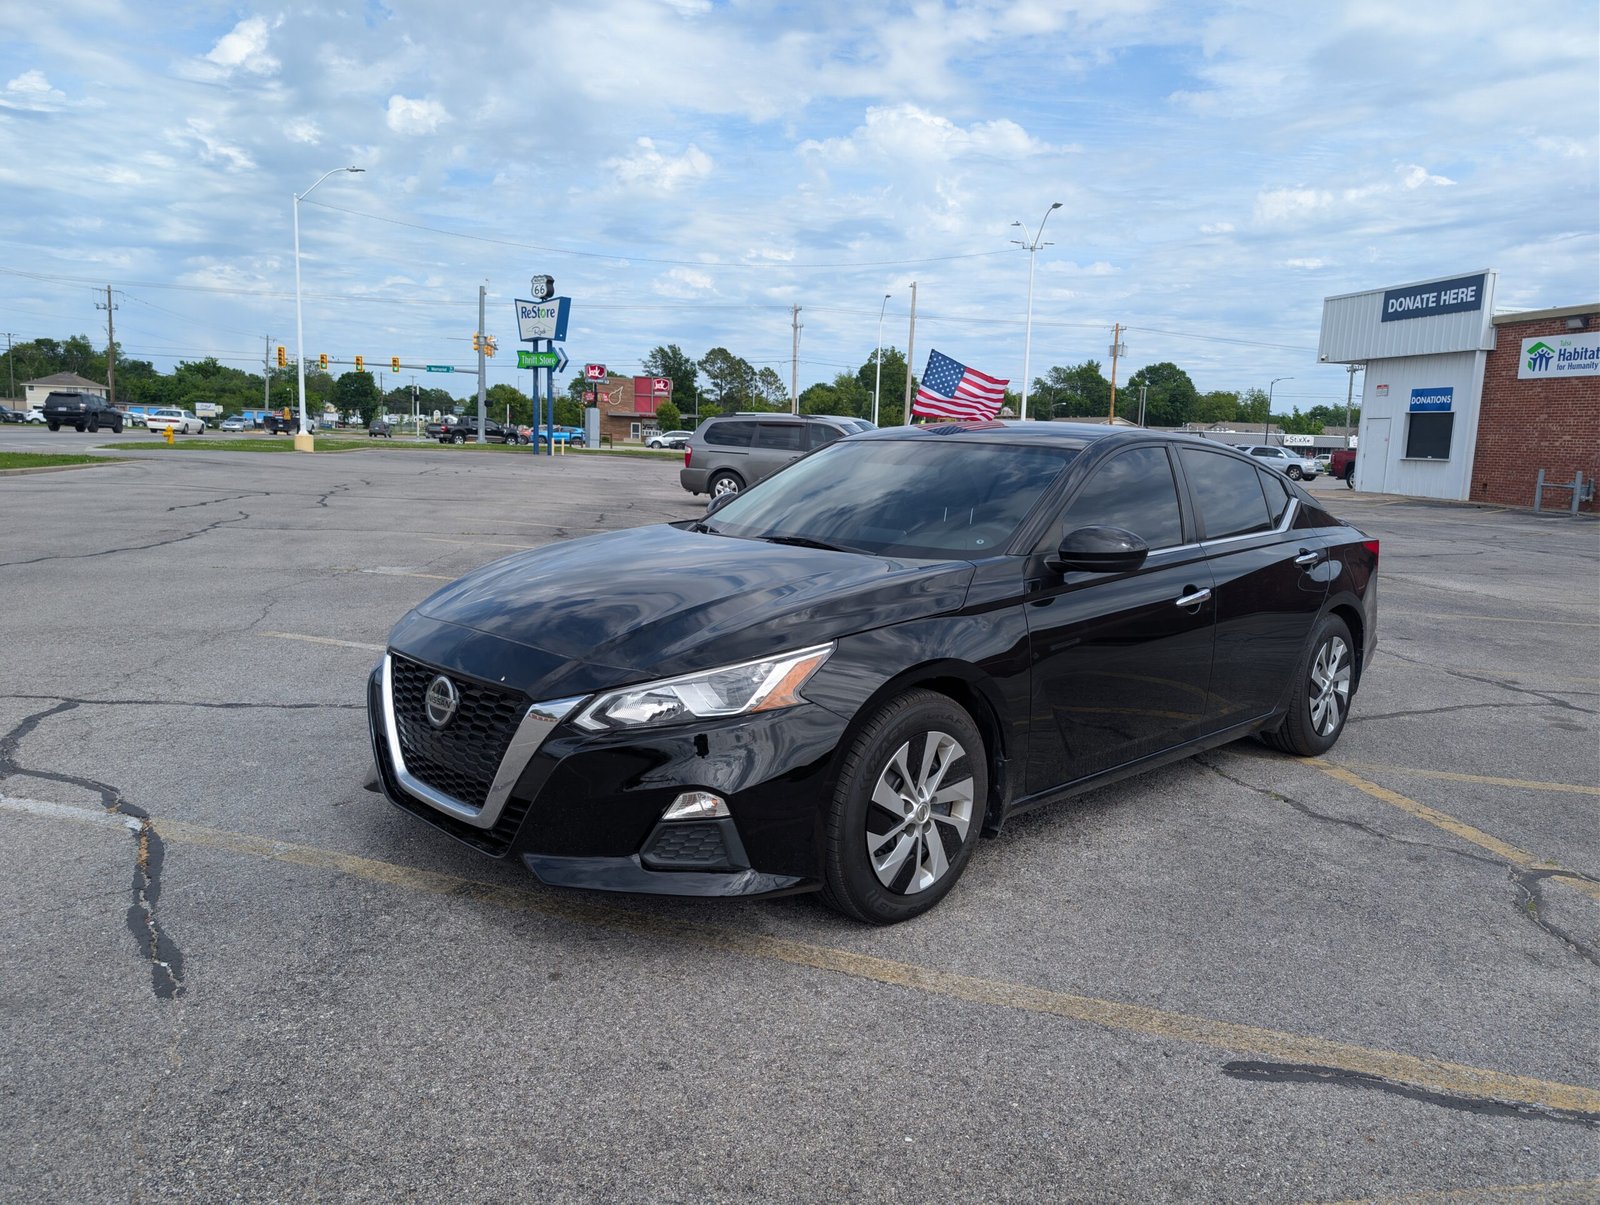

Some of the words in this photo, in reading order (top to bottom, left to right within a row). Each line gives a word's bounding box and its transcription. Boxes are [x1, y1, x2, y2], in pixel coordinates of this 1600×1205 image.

[534, 285, 545, 295] 66
[1388, 292, 1437, 313] DONATE
[1440, 286, 1476, 306] HERE
[521, 306, 555, 319] ReStore
[522, 355, 538, 364] Thrift
[539, 356, 555, 365] Store
[1557, 347, 1600, 362] Habitat
[1556, 363, 1566, 371] for
[1567, 361, 1599, 371] Humanity
[1411, 395, 1452, 404] DONATIONS
[429, 693, 453, 709] NISSAN
